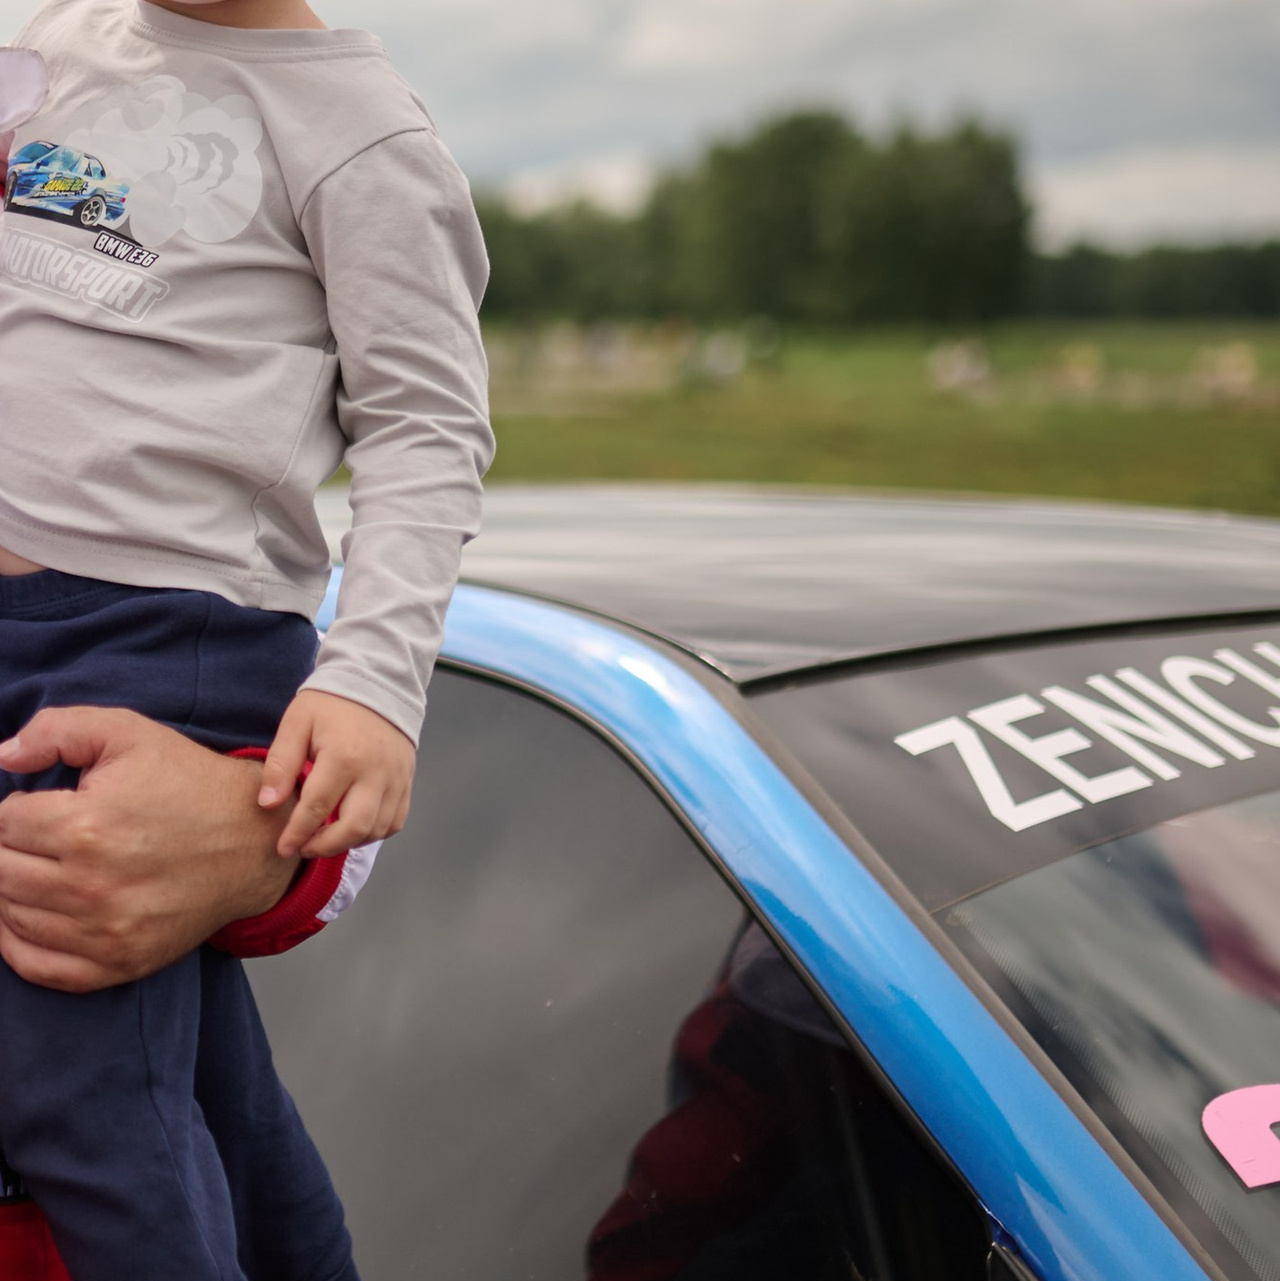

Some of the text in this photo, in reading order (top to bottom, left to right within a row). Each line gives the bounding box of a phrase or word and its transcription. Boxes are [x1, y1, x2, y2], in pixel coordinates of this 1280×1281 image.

[2, 231, 162, 318] MOTORSPORT
[93, 233, 158, 268] BMW E36
